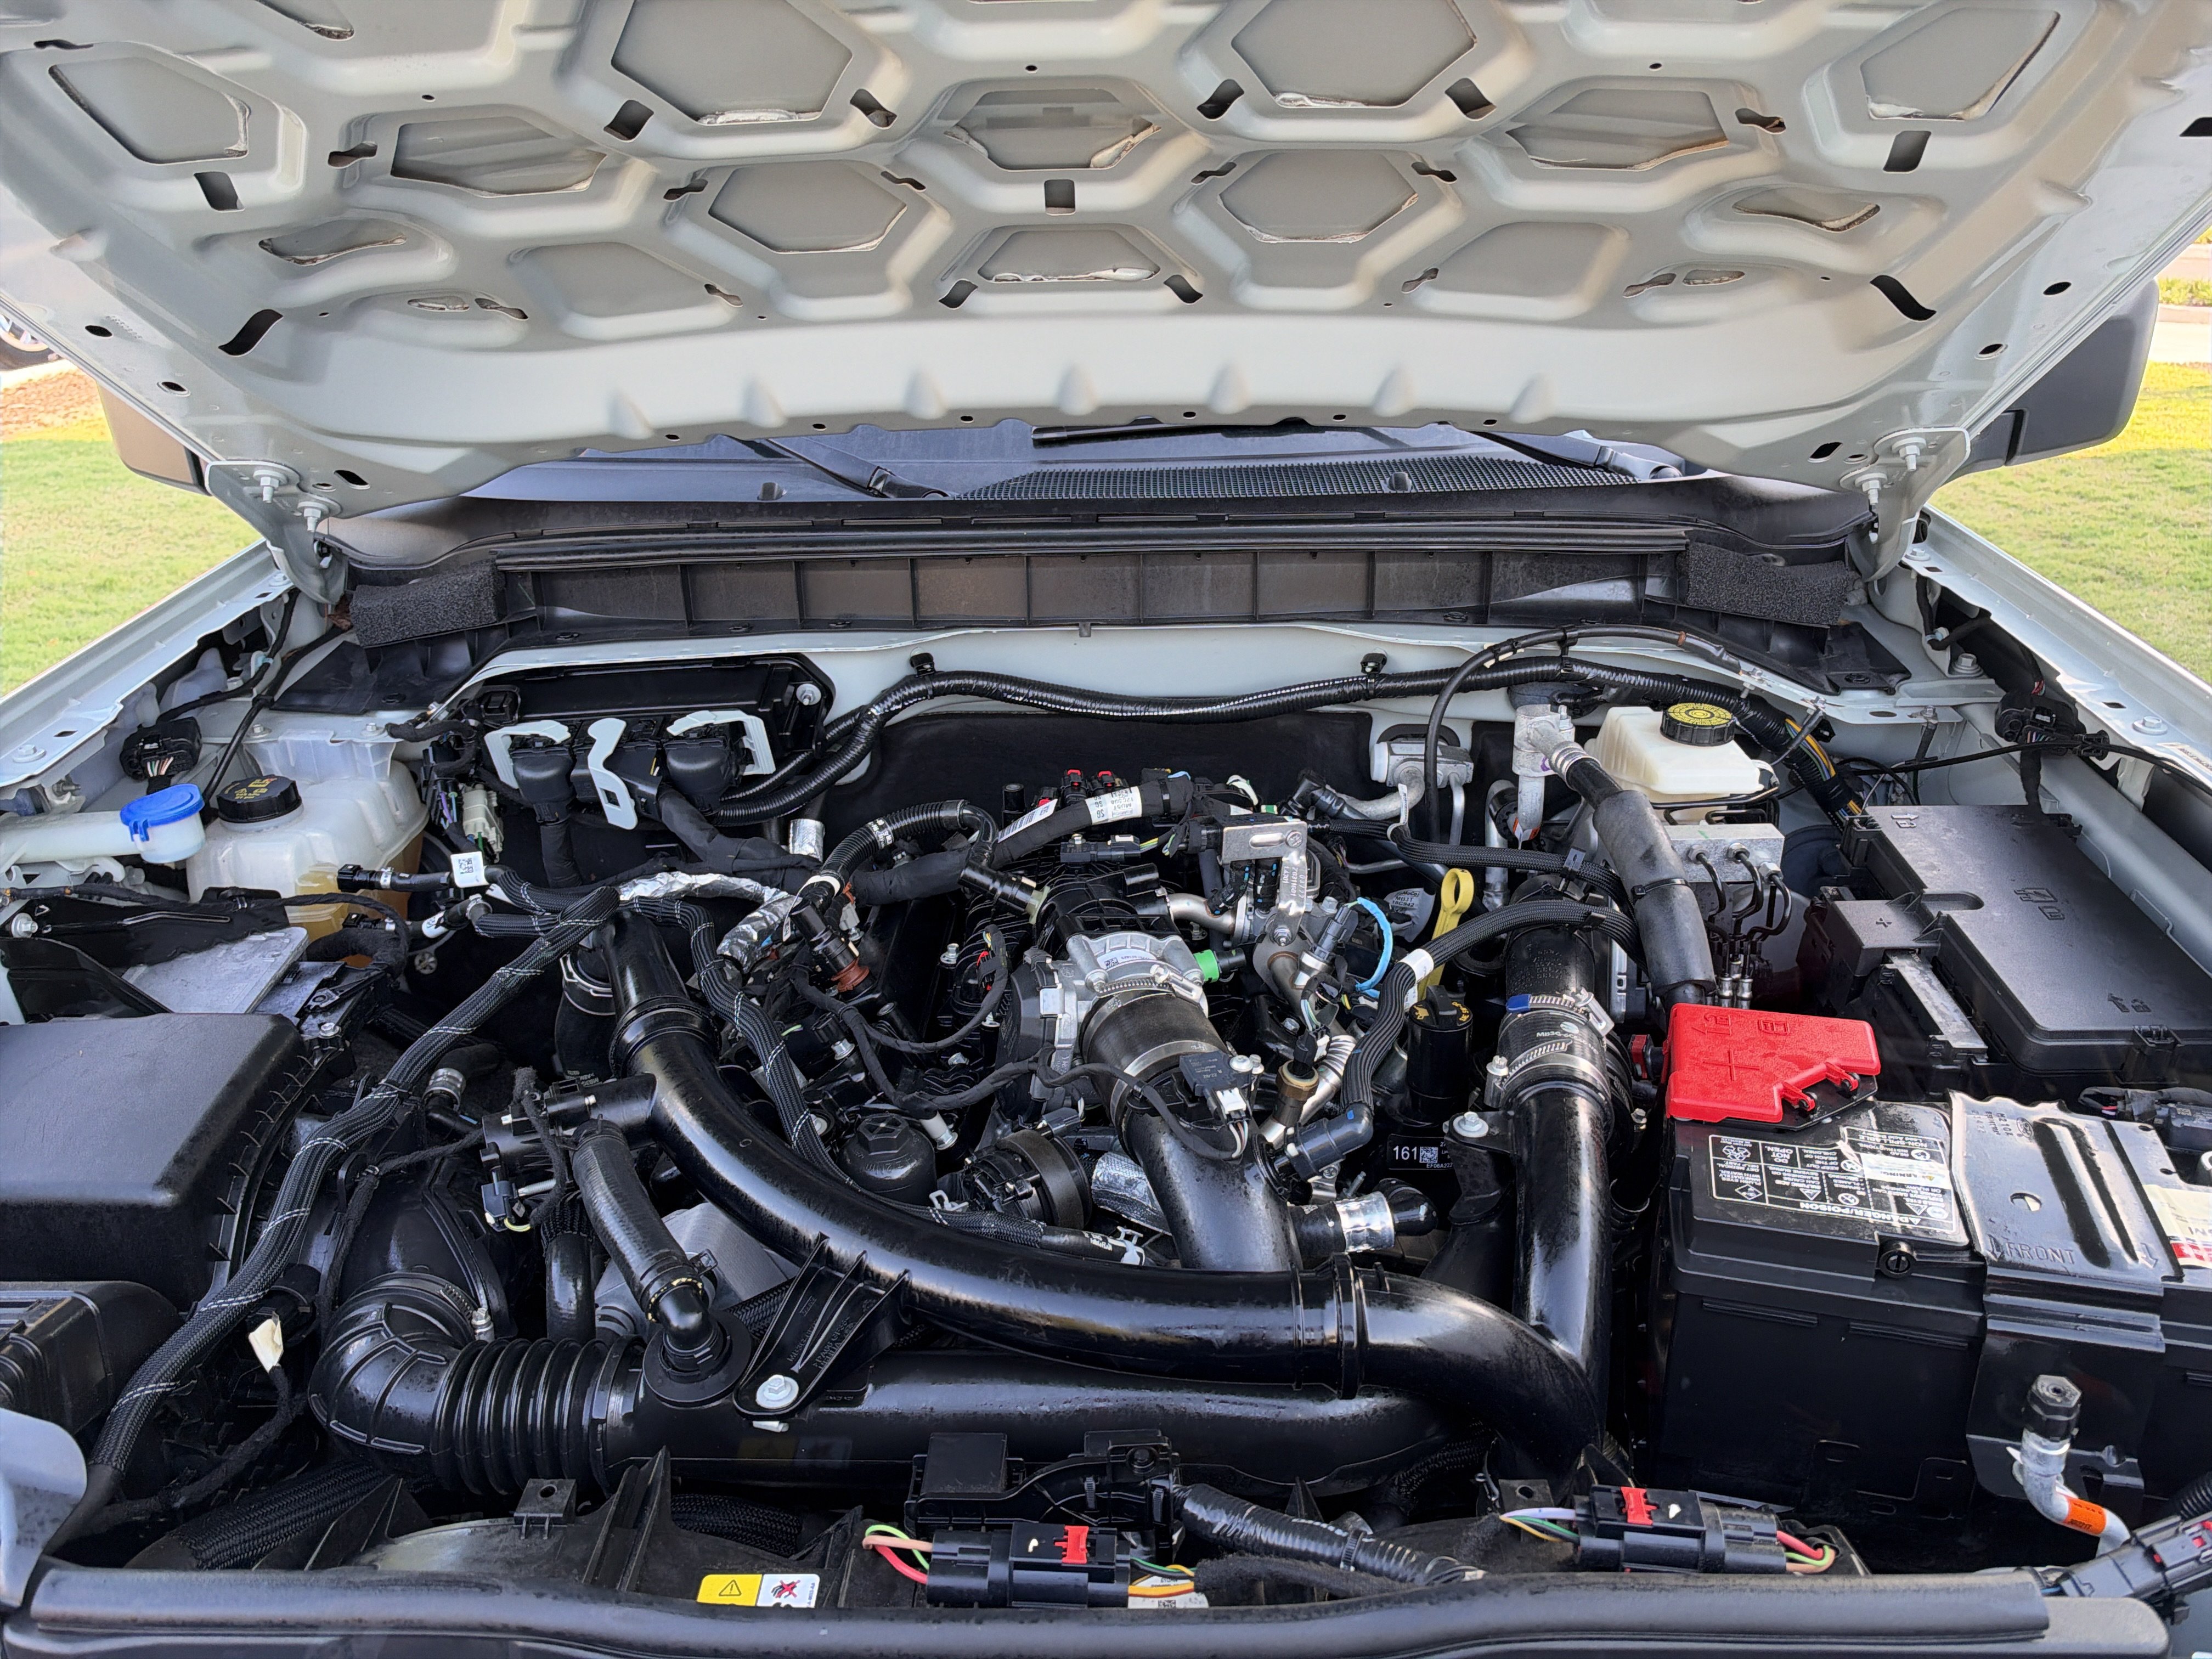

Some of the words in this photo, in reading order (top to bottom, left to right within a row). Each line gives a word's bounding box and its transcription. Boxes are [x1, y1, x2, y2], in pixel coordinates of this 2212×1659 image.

[1393, 1145, 1418, 1160] 161
[1765, 1146, 1793, 1154] OPEN.
[1799, 1202, 1909, 1223] DANGER/POISON
[2005, 1241, 2075, 1265] FRONT
